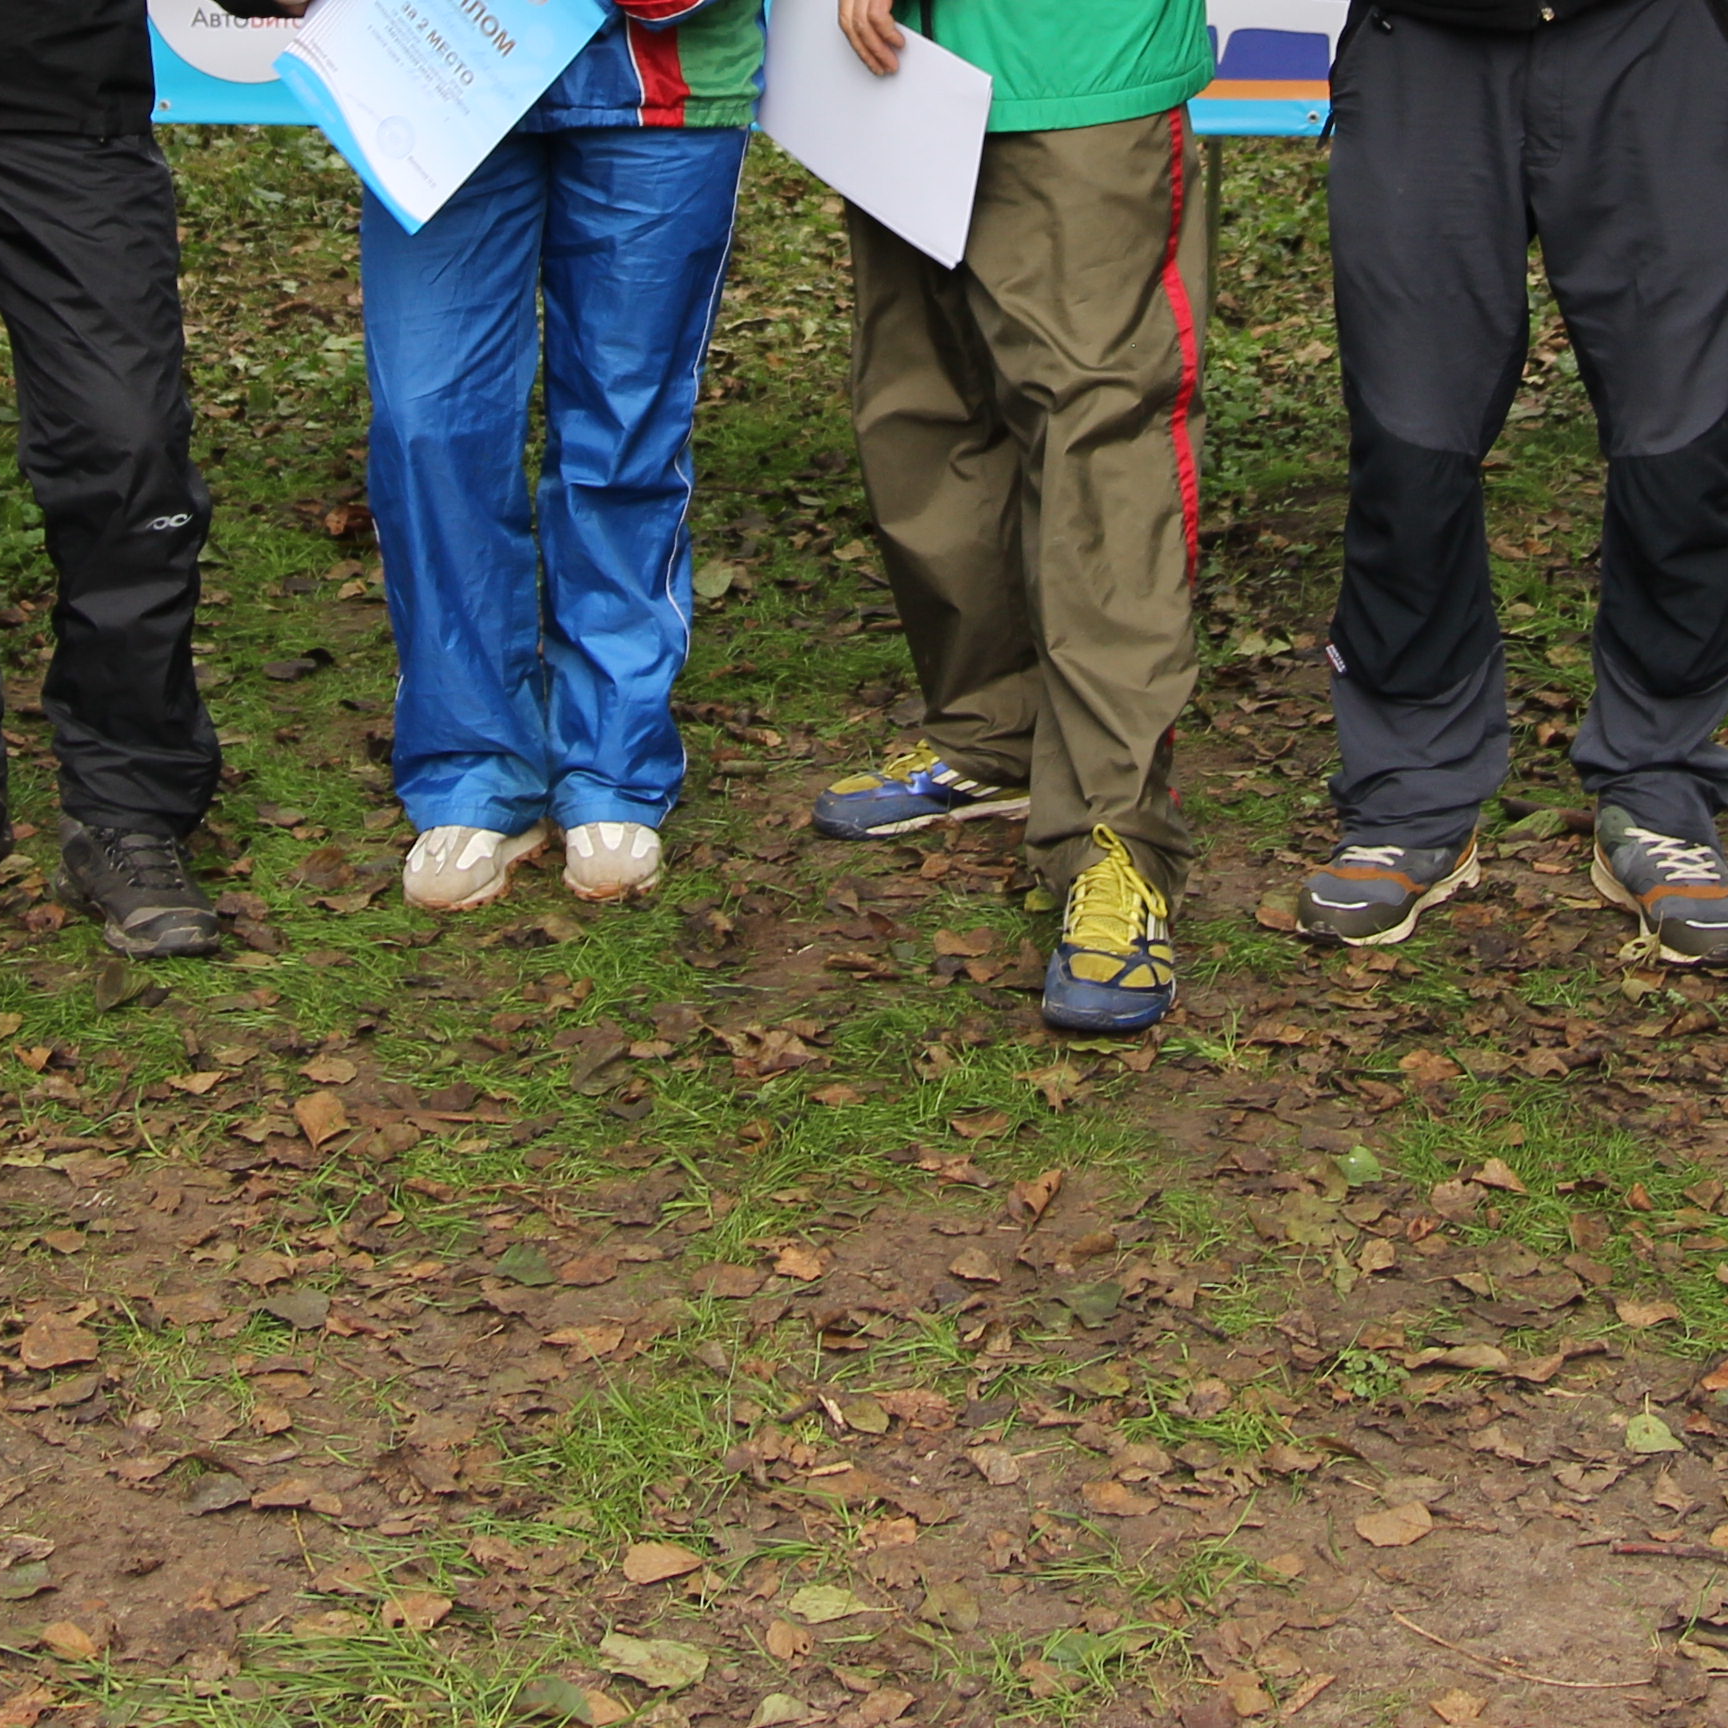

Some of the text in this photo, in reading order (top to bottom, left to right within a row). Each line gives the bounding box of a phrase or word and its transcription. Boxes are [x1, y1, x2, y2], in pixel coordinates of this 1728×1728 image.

[401, 1, 475, 86] за 2 МЕСТО
